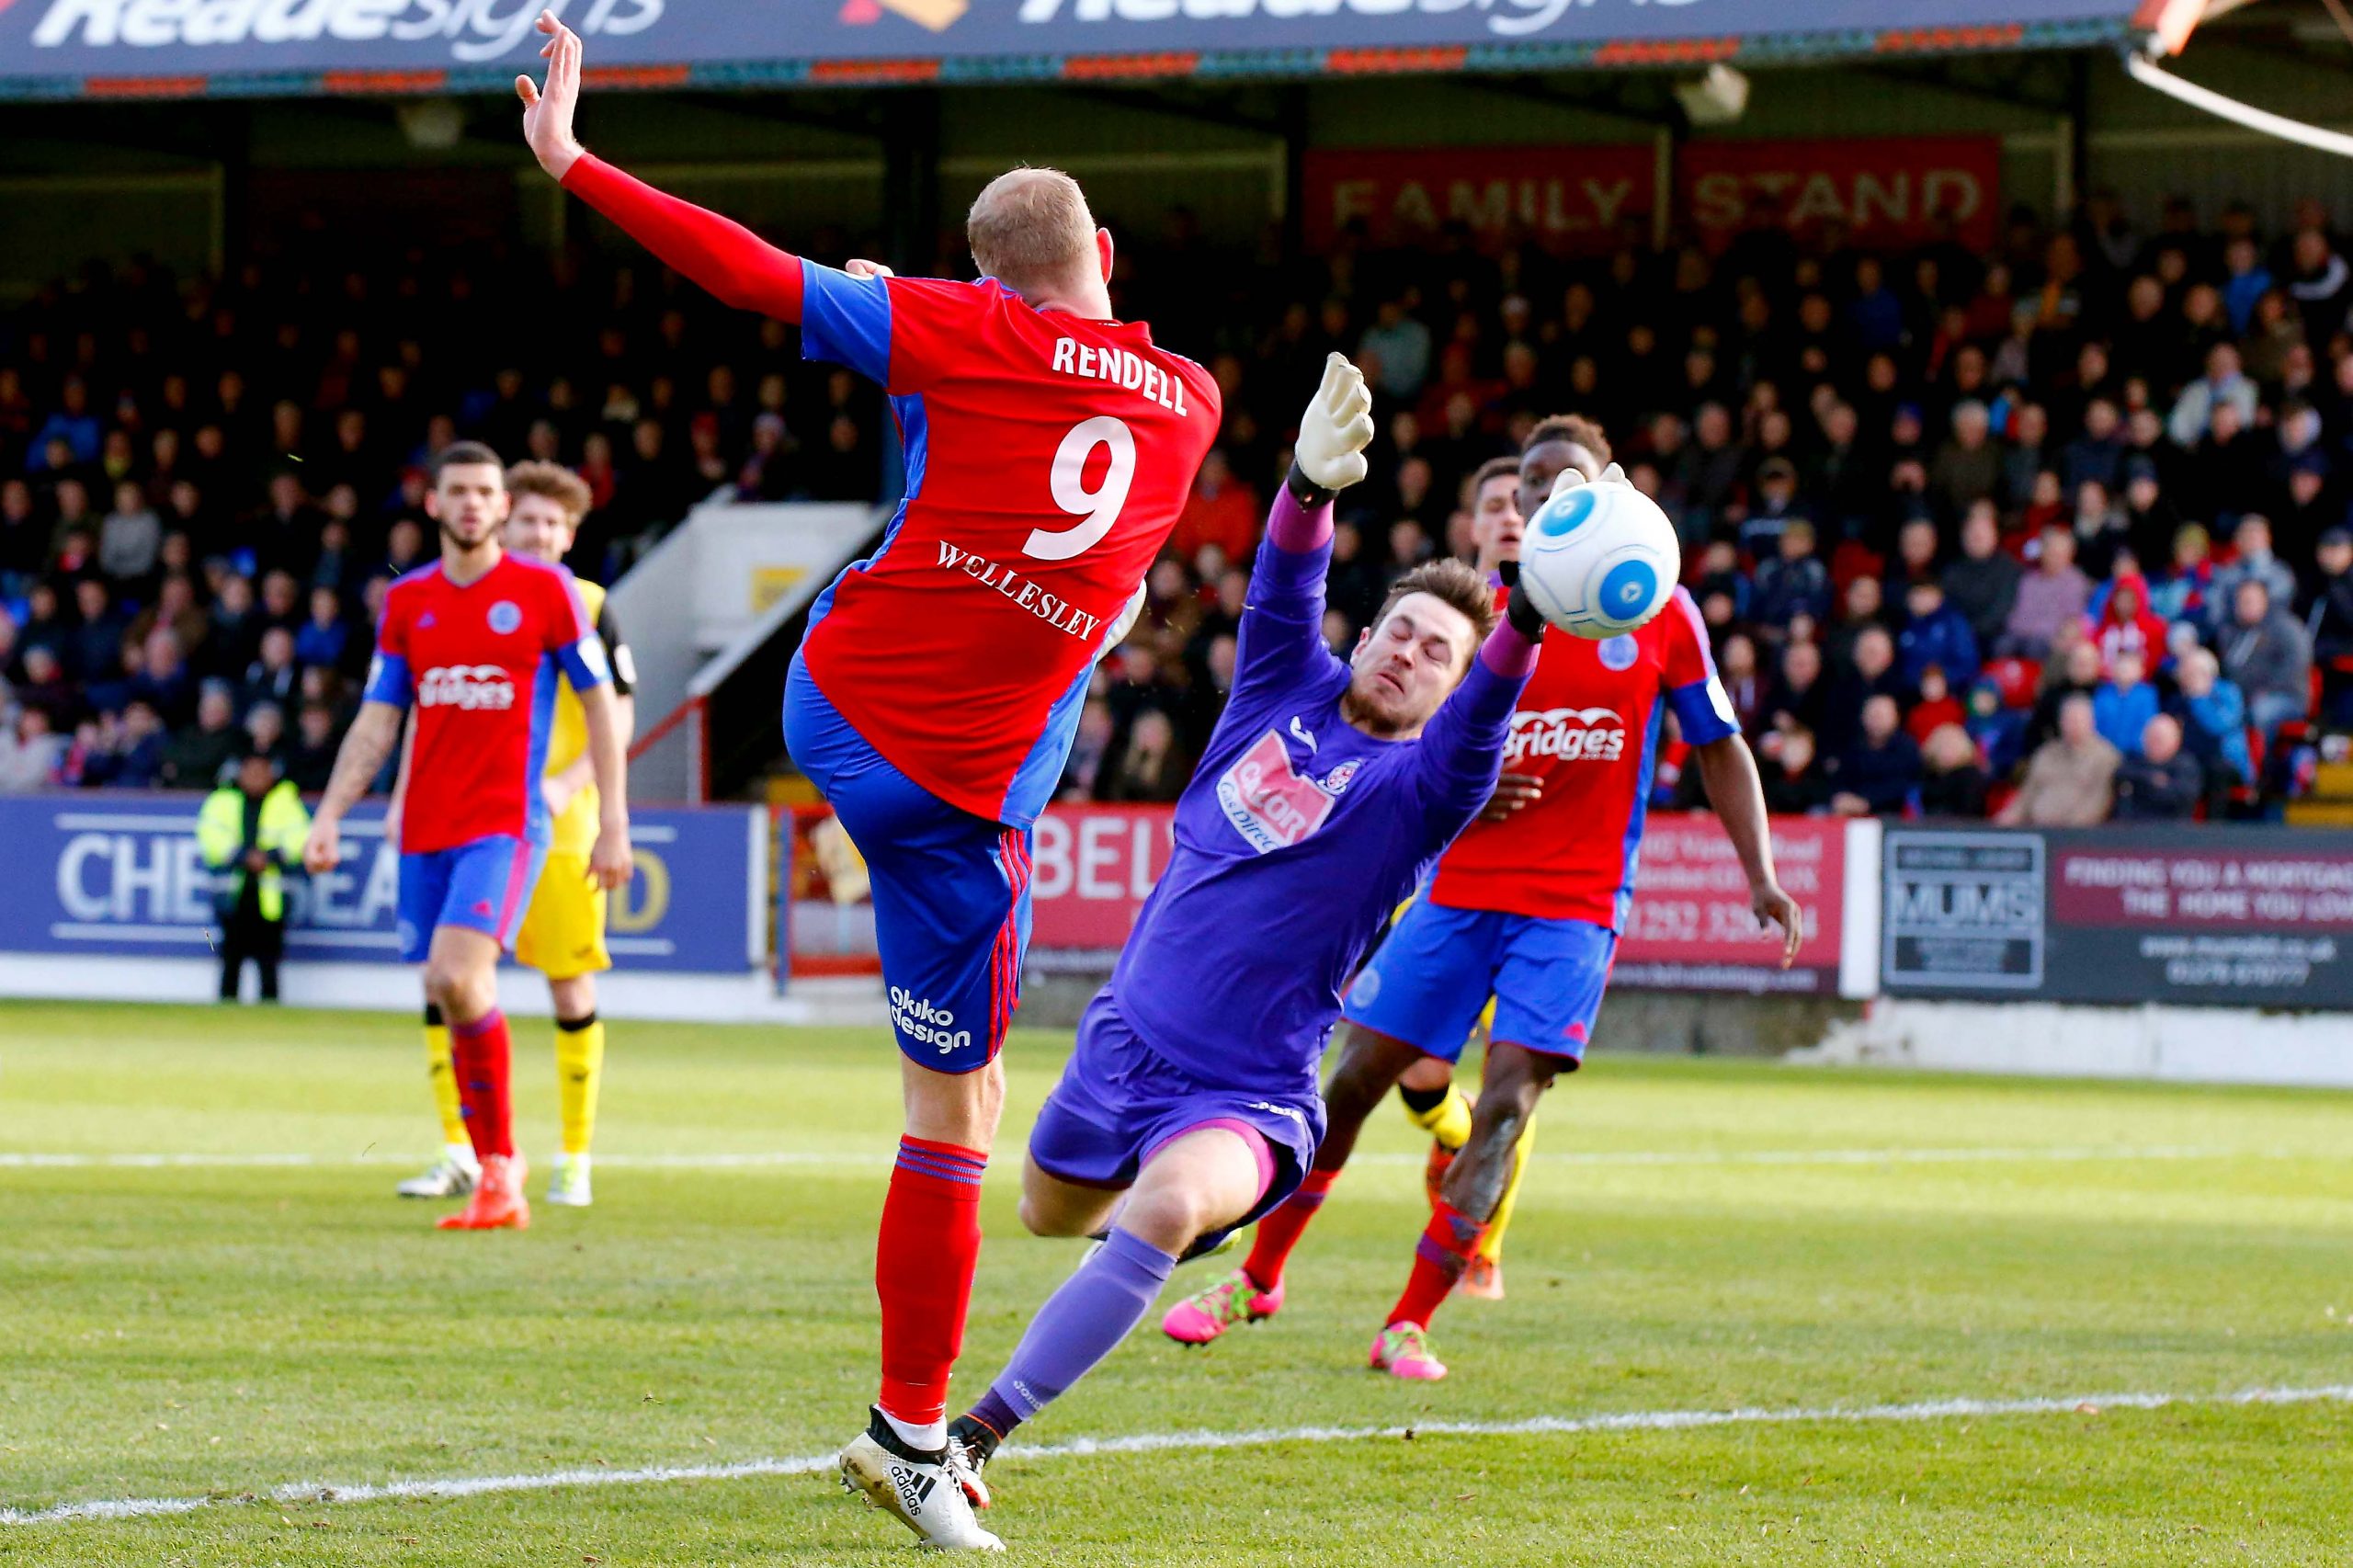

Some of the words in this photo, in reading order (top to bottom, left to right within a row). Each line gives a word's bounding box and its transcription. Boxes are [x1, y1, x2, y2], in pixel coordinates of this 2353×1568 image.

[1334, 180, 1632, 230] FAMILY
[1695, 171, 1980, 228] STAND
[1052, 336, 1188, 416] RENDELL
[1021, 415, 1137, 561] 9
[937, 540, 1101, 642] WELLESLEY
[1232, 810, 1280, 849] Direc
[56, 833, 400, 928] CHEEA
[1031, 815, 1176, 901] BEL
[2066, 858, 2166, 887] FINDING
[2170, 860, 2221, 888] YOU
[2222, 861, 2242, 887] A
[1893, 882, 2036, 928] MUMS
[2122, 887, 2169, 917] THE
[2178, 889, 2248, 919] HOME
[2254, 892, 2304, 920] YOU
[891, 1005, 971, 1054] design
[892, 1466, 922, 1516] adidas
